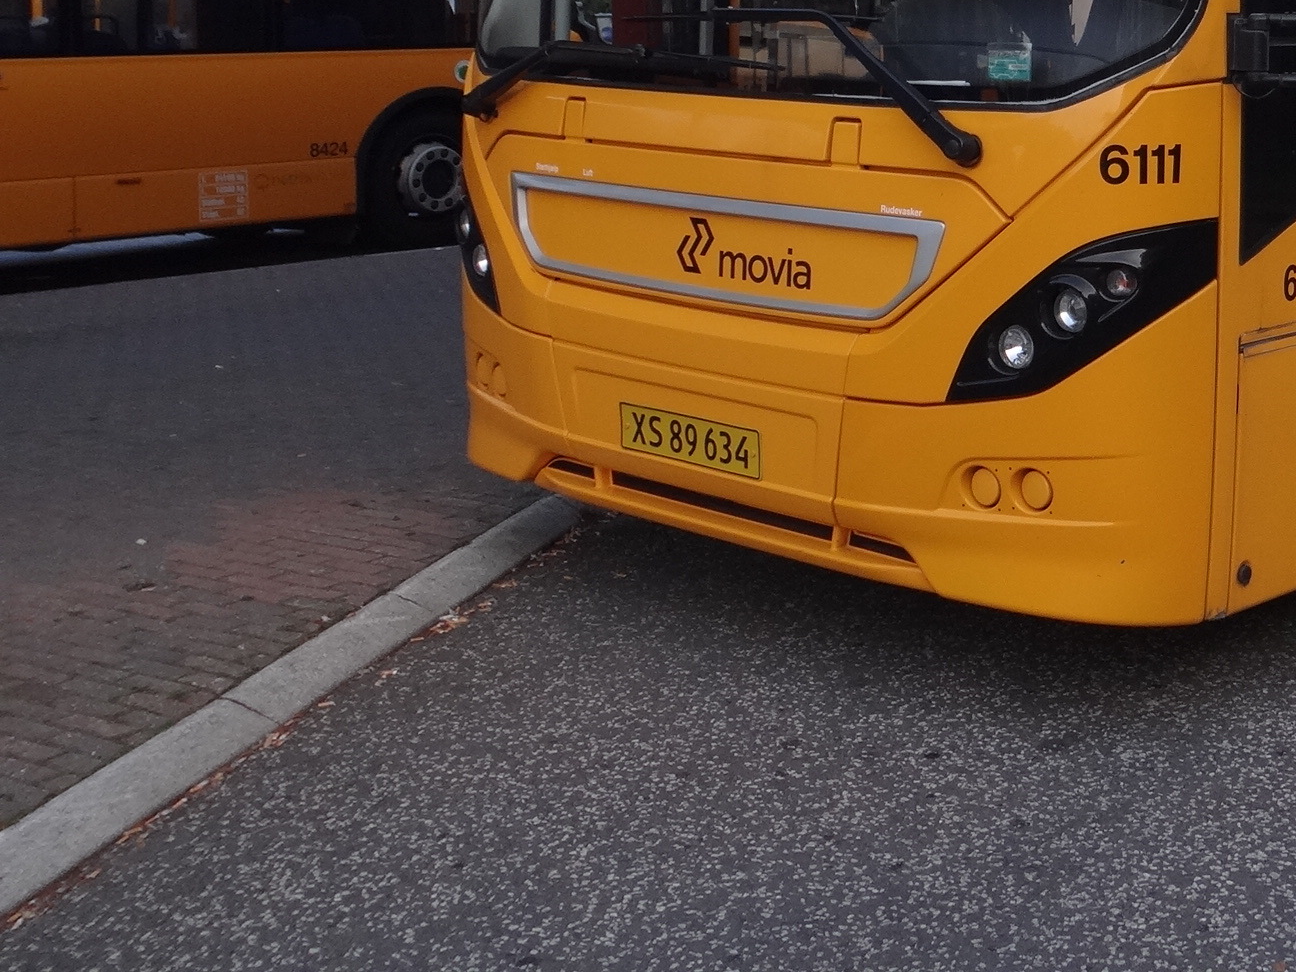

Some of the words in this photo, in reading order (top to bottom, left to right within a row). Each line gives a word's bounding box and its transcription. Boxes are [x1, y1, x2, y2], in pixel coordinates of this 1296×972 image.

[310, 141, 348, 157] 8424
[1100, 144, 1181, 185] 6111
[718, 247, 812, 290] movia
[632, 411, 663, 448] XS
[670, 419, 697, 457] 89
[704, 427, 749, 469] 634
